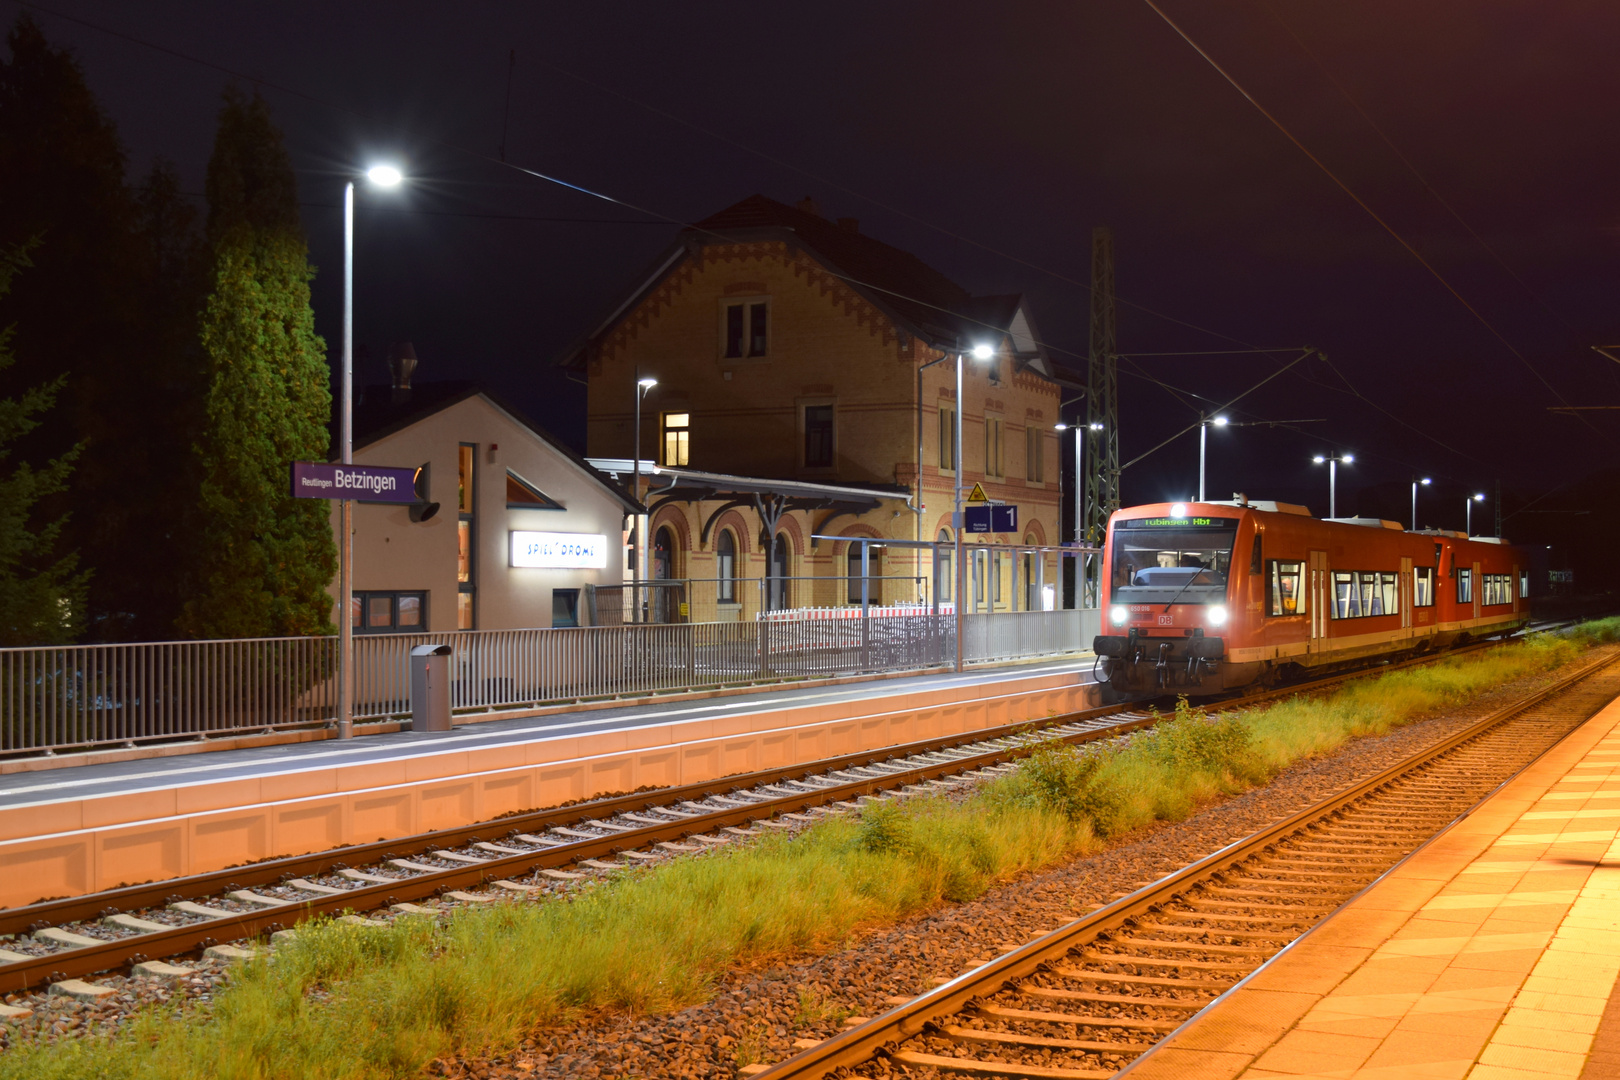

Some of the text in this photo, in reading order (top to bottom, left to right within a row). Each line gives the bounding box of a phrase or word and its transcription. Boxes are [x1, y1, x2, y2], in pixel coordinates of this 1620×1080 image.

[302, 469, 396, 494] Reutlingen Betzingen
[1006, 508, 1014, 527] 1
[1159, 616, 1172, 624] DB
